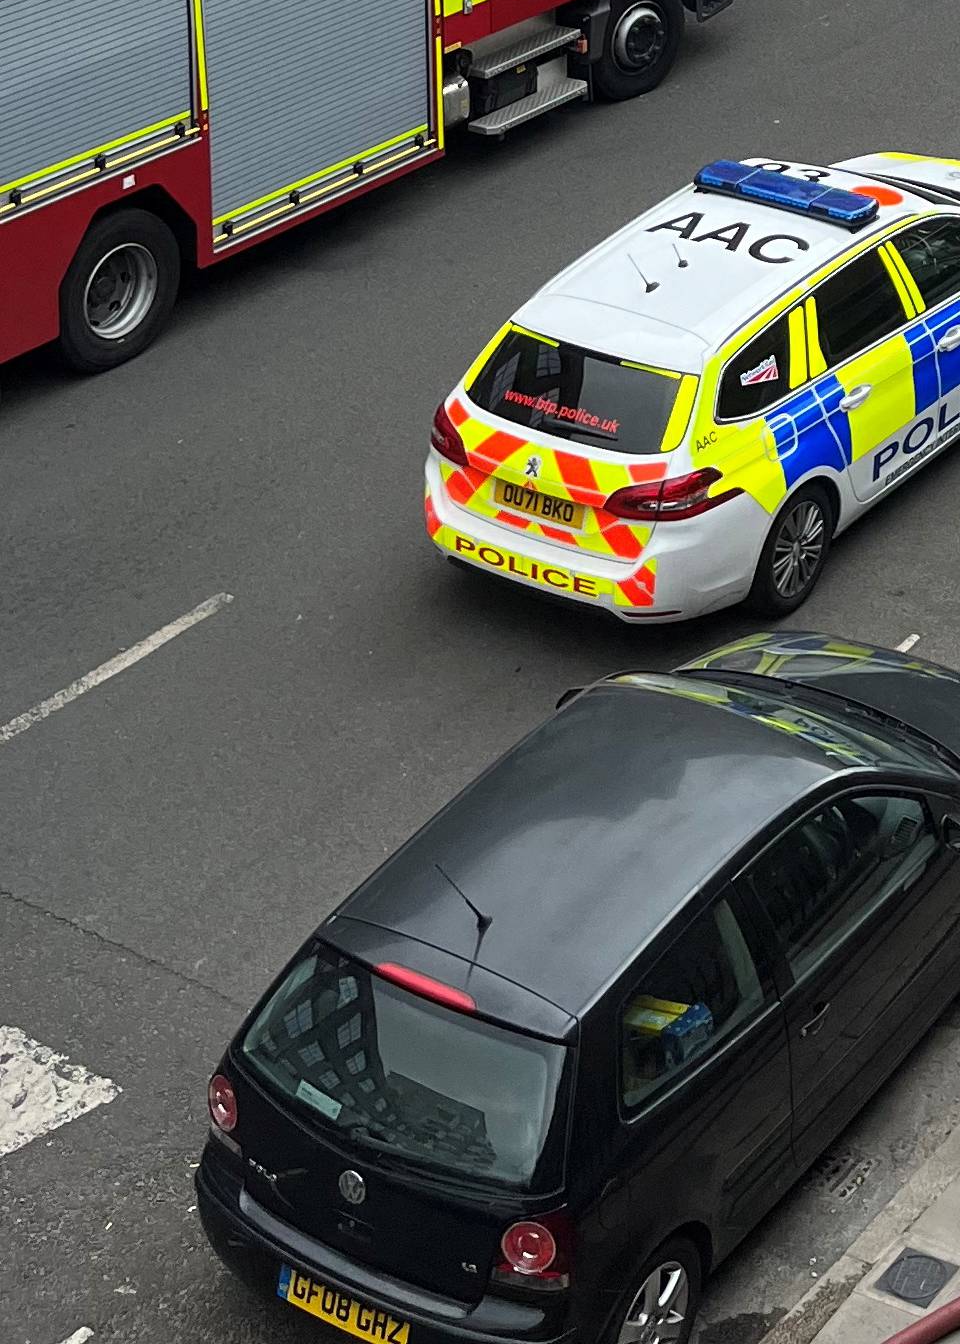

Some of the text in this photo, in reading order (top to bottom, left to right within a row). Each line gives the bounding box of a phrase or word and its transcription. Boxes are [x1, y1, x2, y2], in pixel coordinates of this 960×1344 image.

[644, 211, 810, 264] AAC
[503, 389, 621, 433] www.btp.police.uk
[695, 430, 718, 453] AAC
[503, 484, 575, 523] OU71 BKO
[455, 535, 598, 598] POLICE
[292, 1273, 406, 1344] GF08 GHZ
